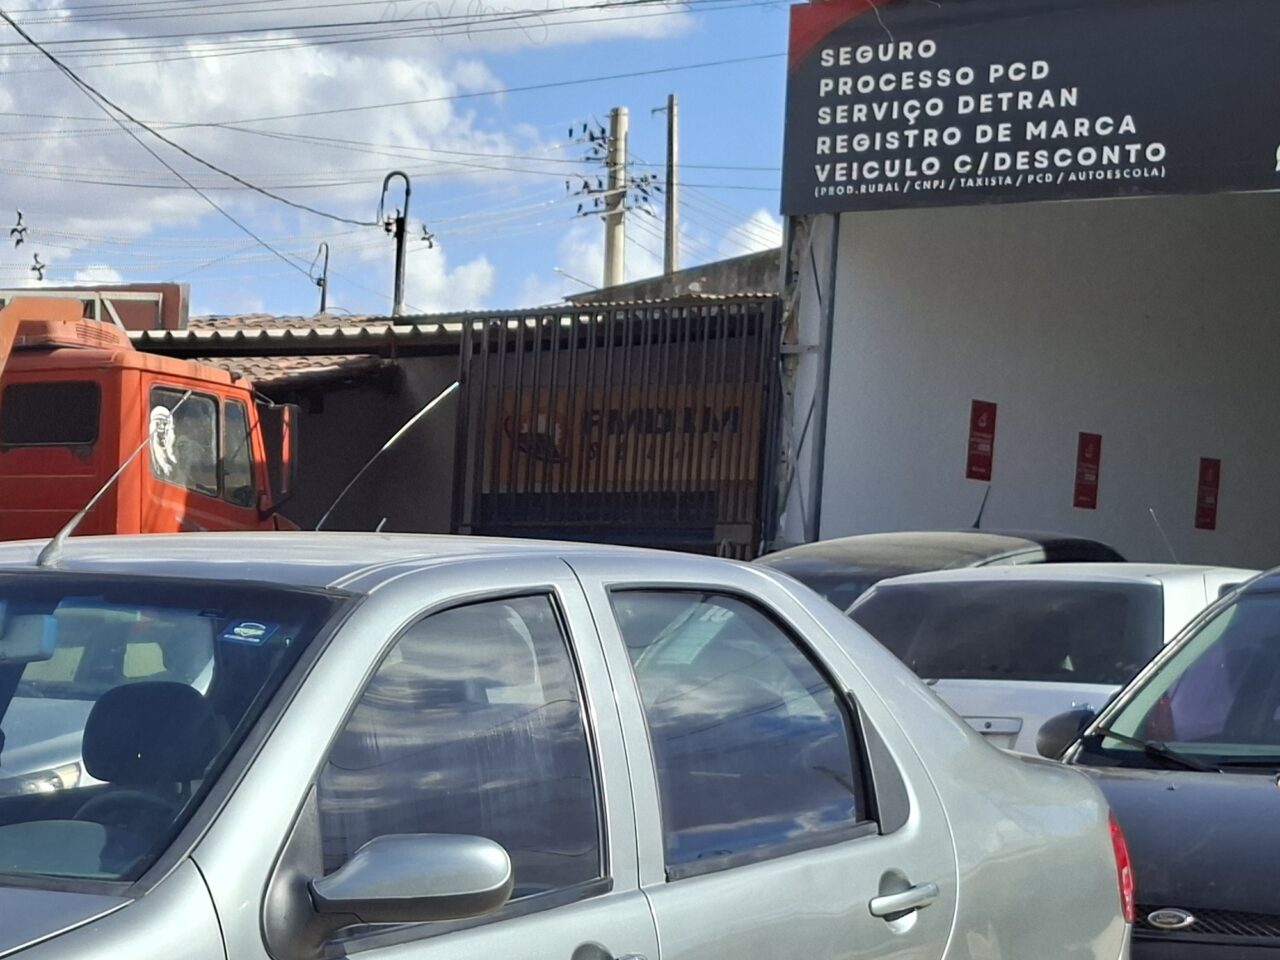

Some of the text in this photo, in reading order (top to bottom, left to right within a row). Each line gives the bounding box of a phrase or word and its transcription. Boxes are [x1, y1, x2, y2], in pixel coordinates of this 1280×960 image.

[820, 39, 936, 67] SEGURO
[819, 60, 1049, 97] PROCESSO PCD
[817, 87, 1078, 126] SERVIÇO DETRAN
[816, 114, 1136, 155] REGISTRO DE MARCA
[814, 142, 1166, 183] VEICULO C/DESCONTO
[959, 174, 1013, 188] TAXISTA
[1027, 172, 1054, 184] PCD
